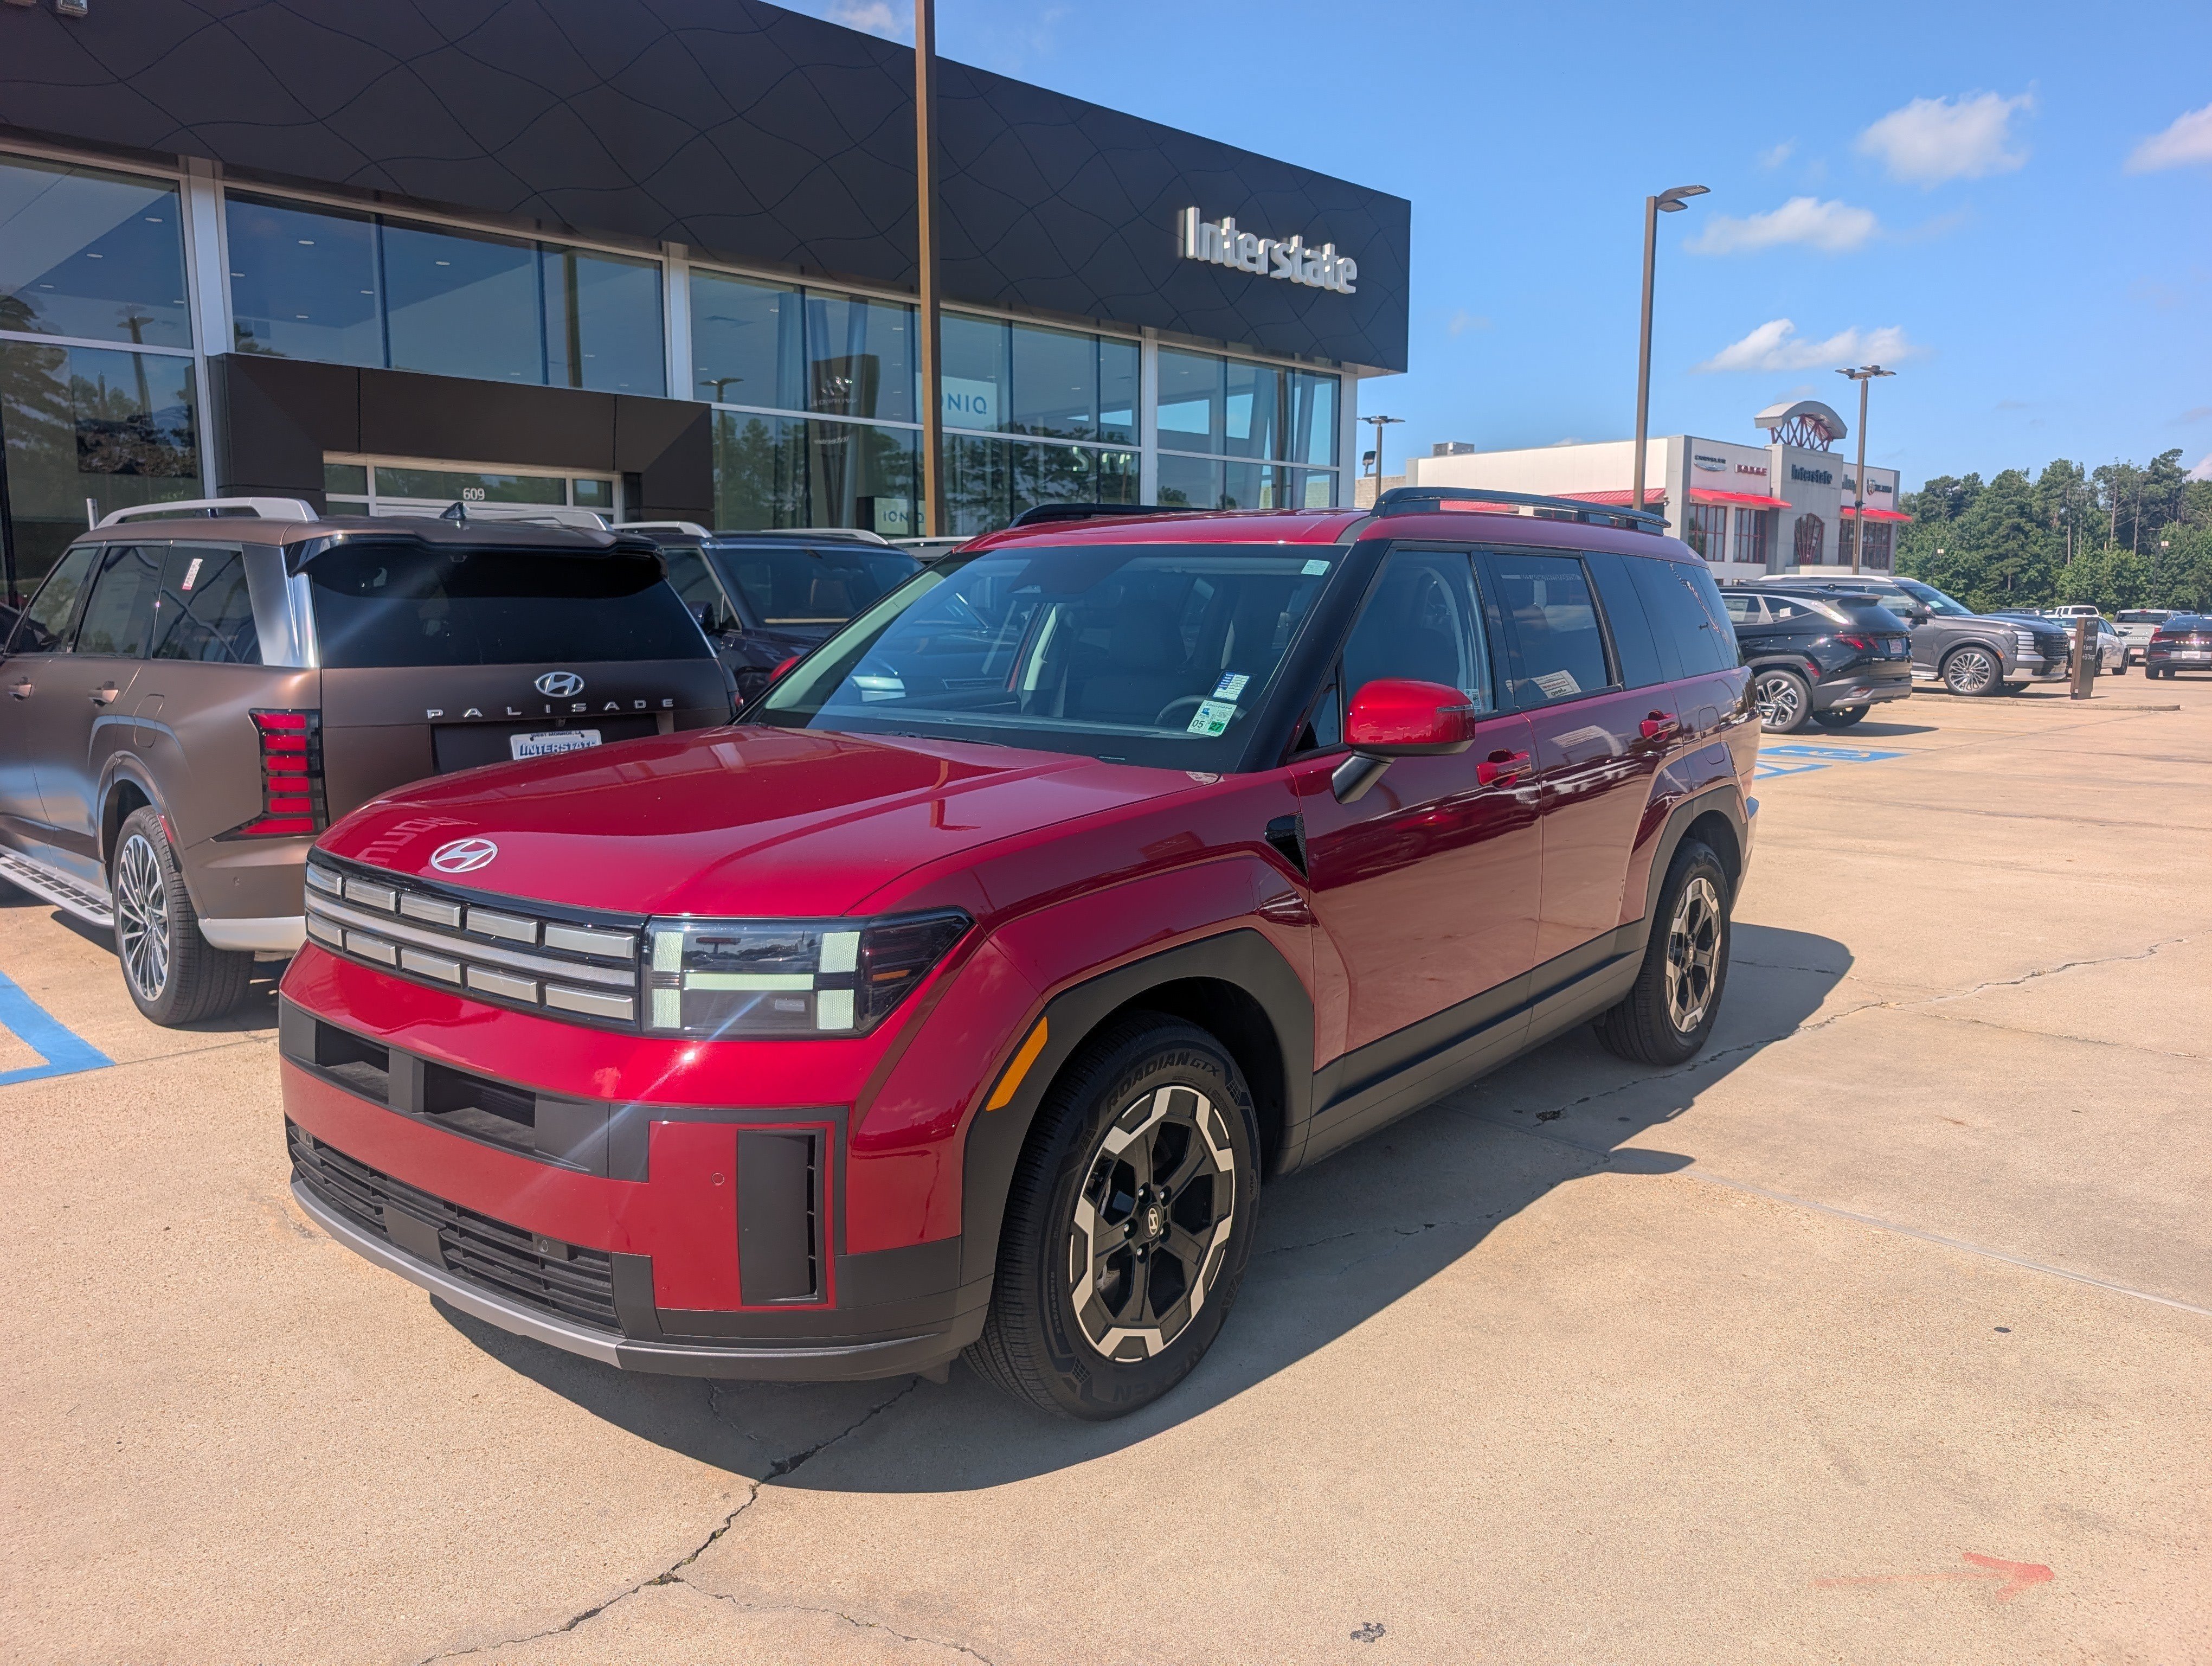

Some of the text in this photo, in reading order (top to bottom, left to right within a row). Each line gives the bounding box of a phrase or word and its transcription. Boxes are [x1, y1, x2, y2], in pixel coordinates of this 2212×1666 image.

[1186, 207, 1357, 294] Interstate
[942, 393, 987, 414] NIQ
[1791, 464, 1832, 484] Interstate
[463, 488, 485, 500] 609
[883, 511, 924, 523] IONQ
[427, 699, 673, 719] PALISADE
[1192, 720, 1223, 731] 05 27
[1106, 1051, 1191, 1114] ROADIAN
[1189, 1058, 1219, 1077] GTX
